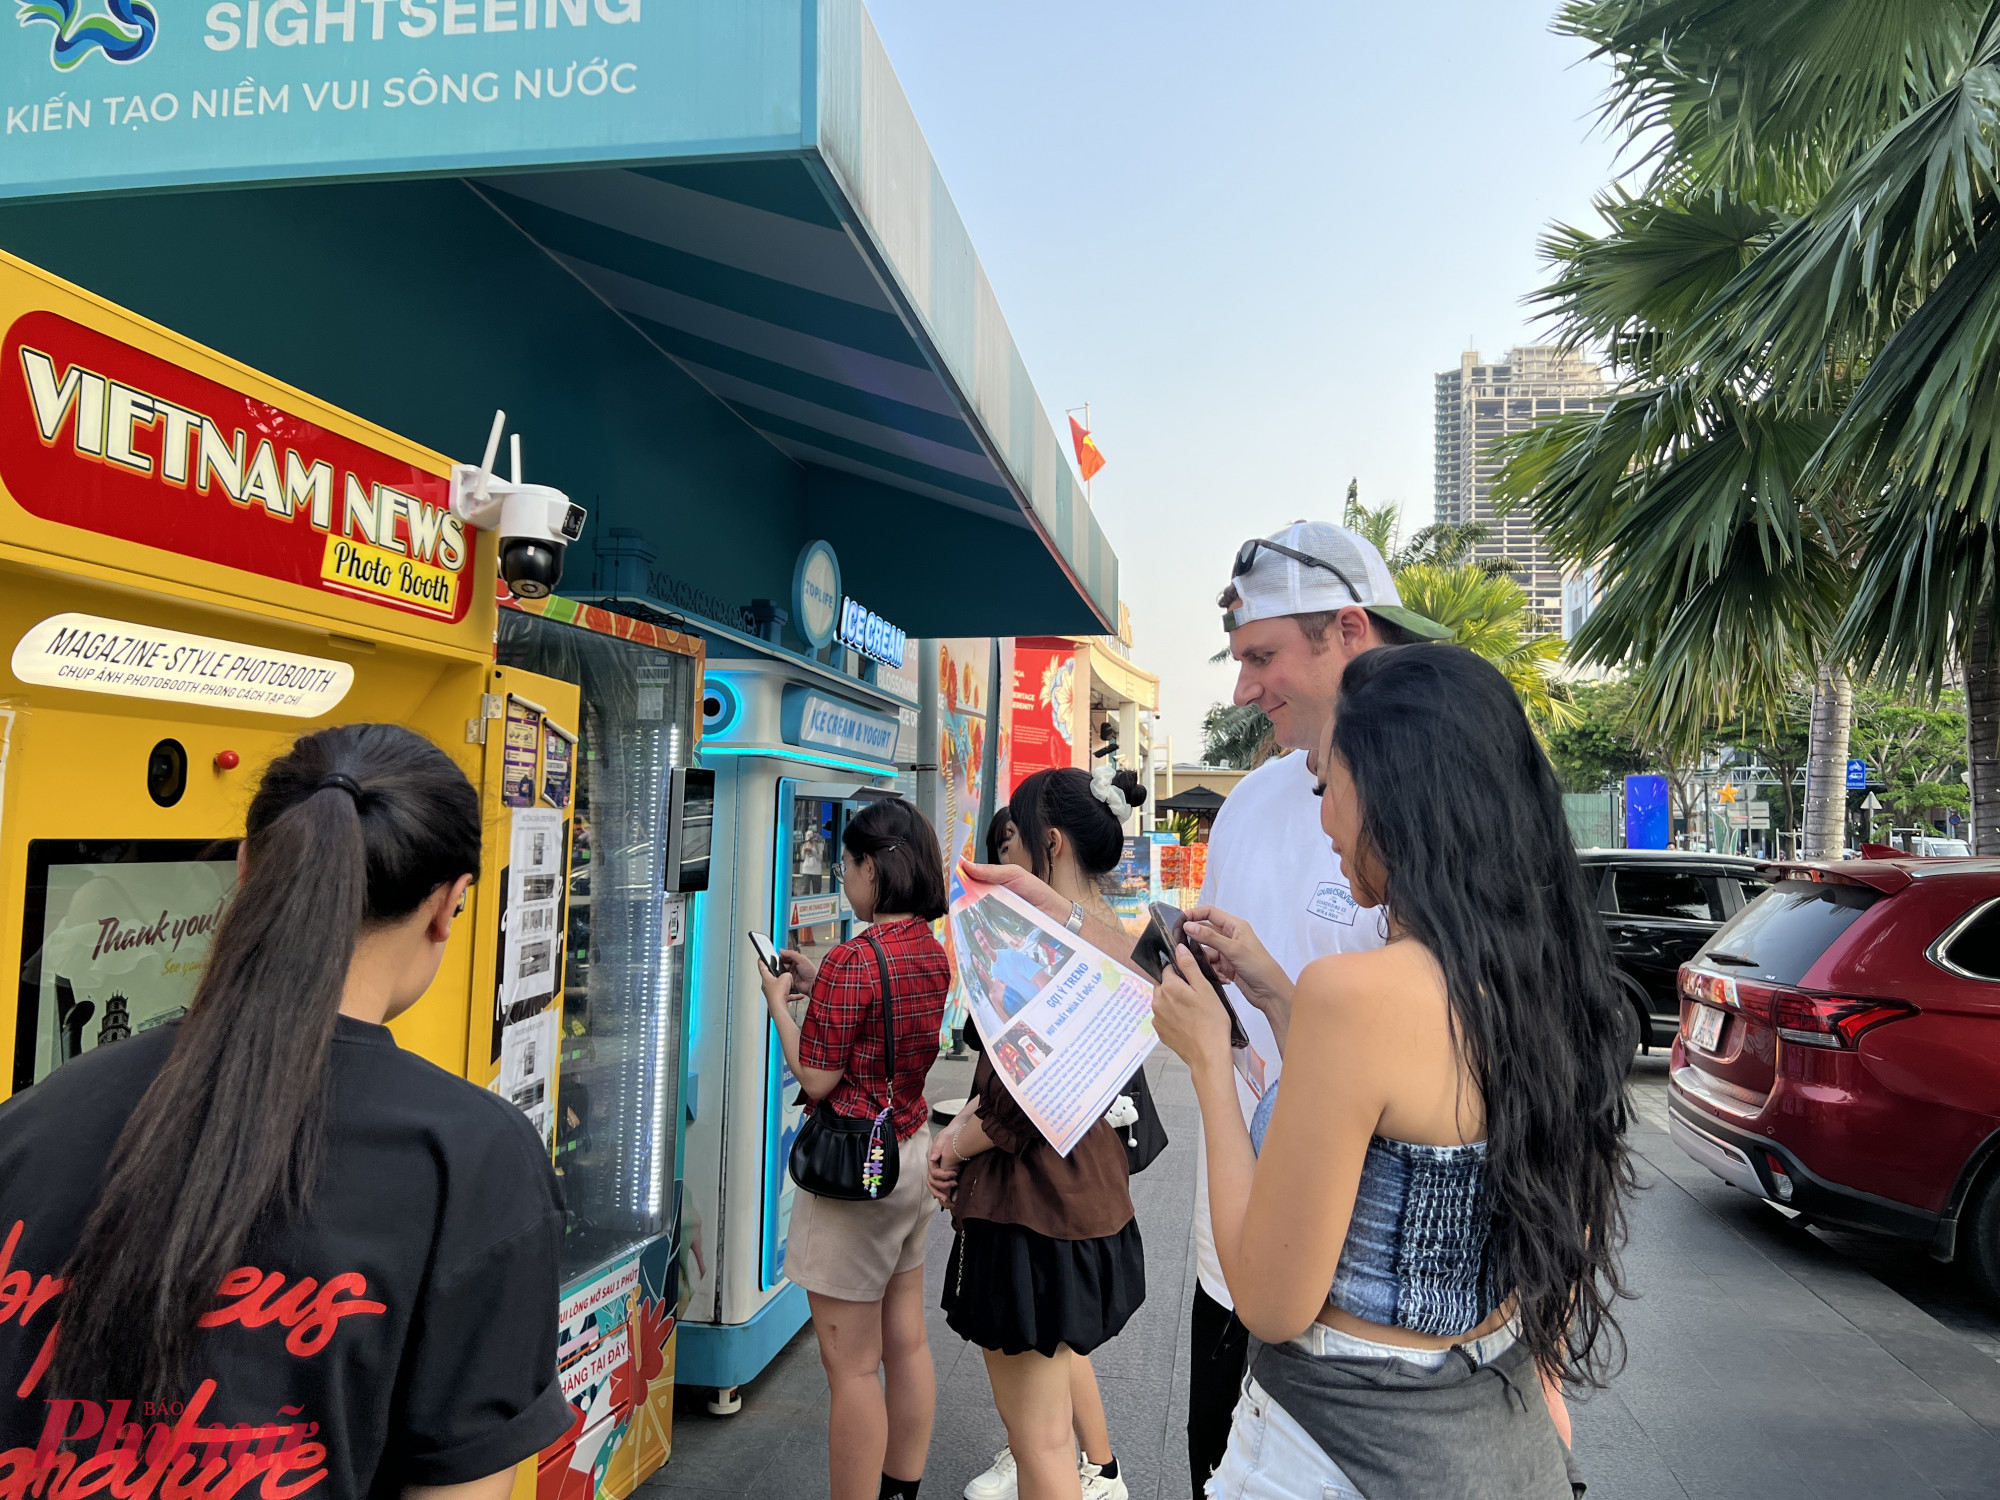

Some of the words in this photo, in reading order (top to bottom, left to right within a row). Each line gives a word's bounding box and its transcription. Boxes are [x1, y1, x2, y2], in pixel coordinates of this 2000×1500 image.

[6, 91, 91, 134] KIẾN
[103, 92, 178, 132] TẠO
[192, 76, 289, 119] NIỀM
[302, 79, 369, 111] VUI
[383, 68, 499, 108] SÔNG
[515, 57, 638, 100] NƯỚC
[20, 345, 334, 531] VIETNAM
[343, 472, 467, 573] NEWS
[334, 541, 392, 587] Photo
[399, 562, 449, 604] Booth
[805, 580, 834, 609] TOPLIFE
[841, 595, 867, 649] ICE
[864, 611, 906, 669] CREAM
[46, 627, 231, 678] MAGAZINE-STYLE
[224, 656, 337, 693] PHOTOBOOTH
[58, 665, 96, 681] CHỤP
[95, 667, 126, 683] ẢNH
[123, 673, 201, 693] PHOTOBOOTH
[199, 684, 236, 697] PHONG
[236, 687, 265, 702] CÁCH
[264, 692, 285, 705] TẠP
[283, 693, 302, 706] CHÍ
[811, 709, 827, 732] ICE
[827, 714, 856, 740] CREAM
[856, 723, 862, 742] &
[863, 724, 892, 749] YOGURT
[92, 909, 170, 961] Thank
[172, 898, 226, 953] you!
[161, 958, 181, 976] See
[1046, 992, 1063, 1008] GỢI
[1056, 985, 1068, 996] Ý
[1063, 962, 1089, 989] TREND
[1046, 1024, 1057, 1036] HOT
[569, 1302, 588, 1319] LÒNG
[590, 1288, 601, 1306] MỞ
[602, 1279, 616, 1298] SAU
[621, 1268, 638, 1288] PHÚT
[591, 1356, 606, 1375] TẠI
[608, 1341, 627, 1365] ĐÂY
